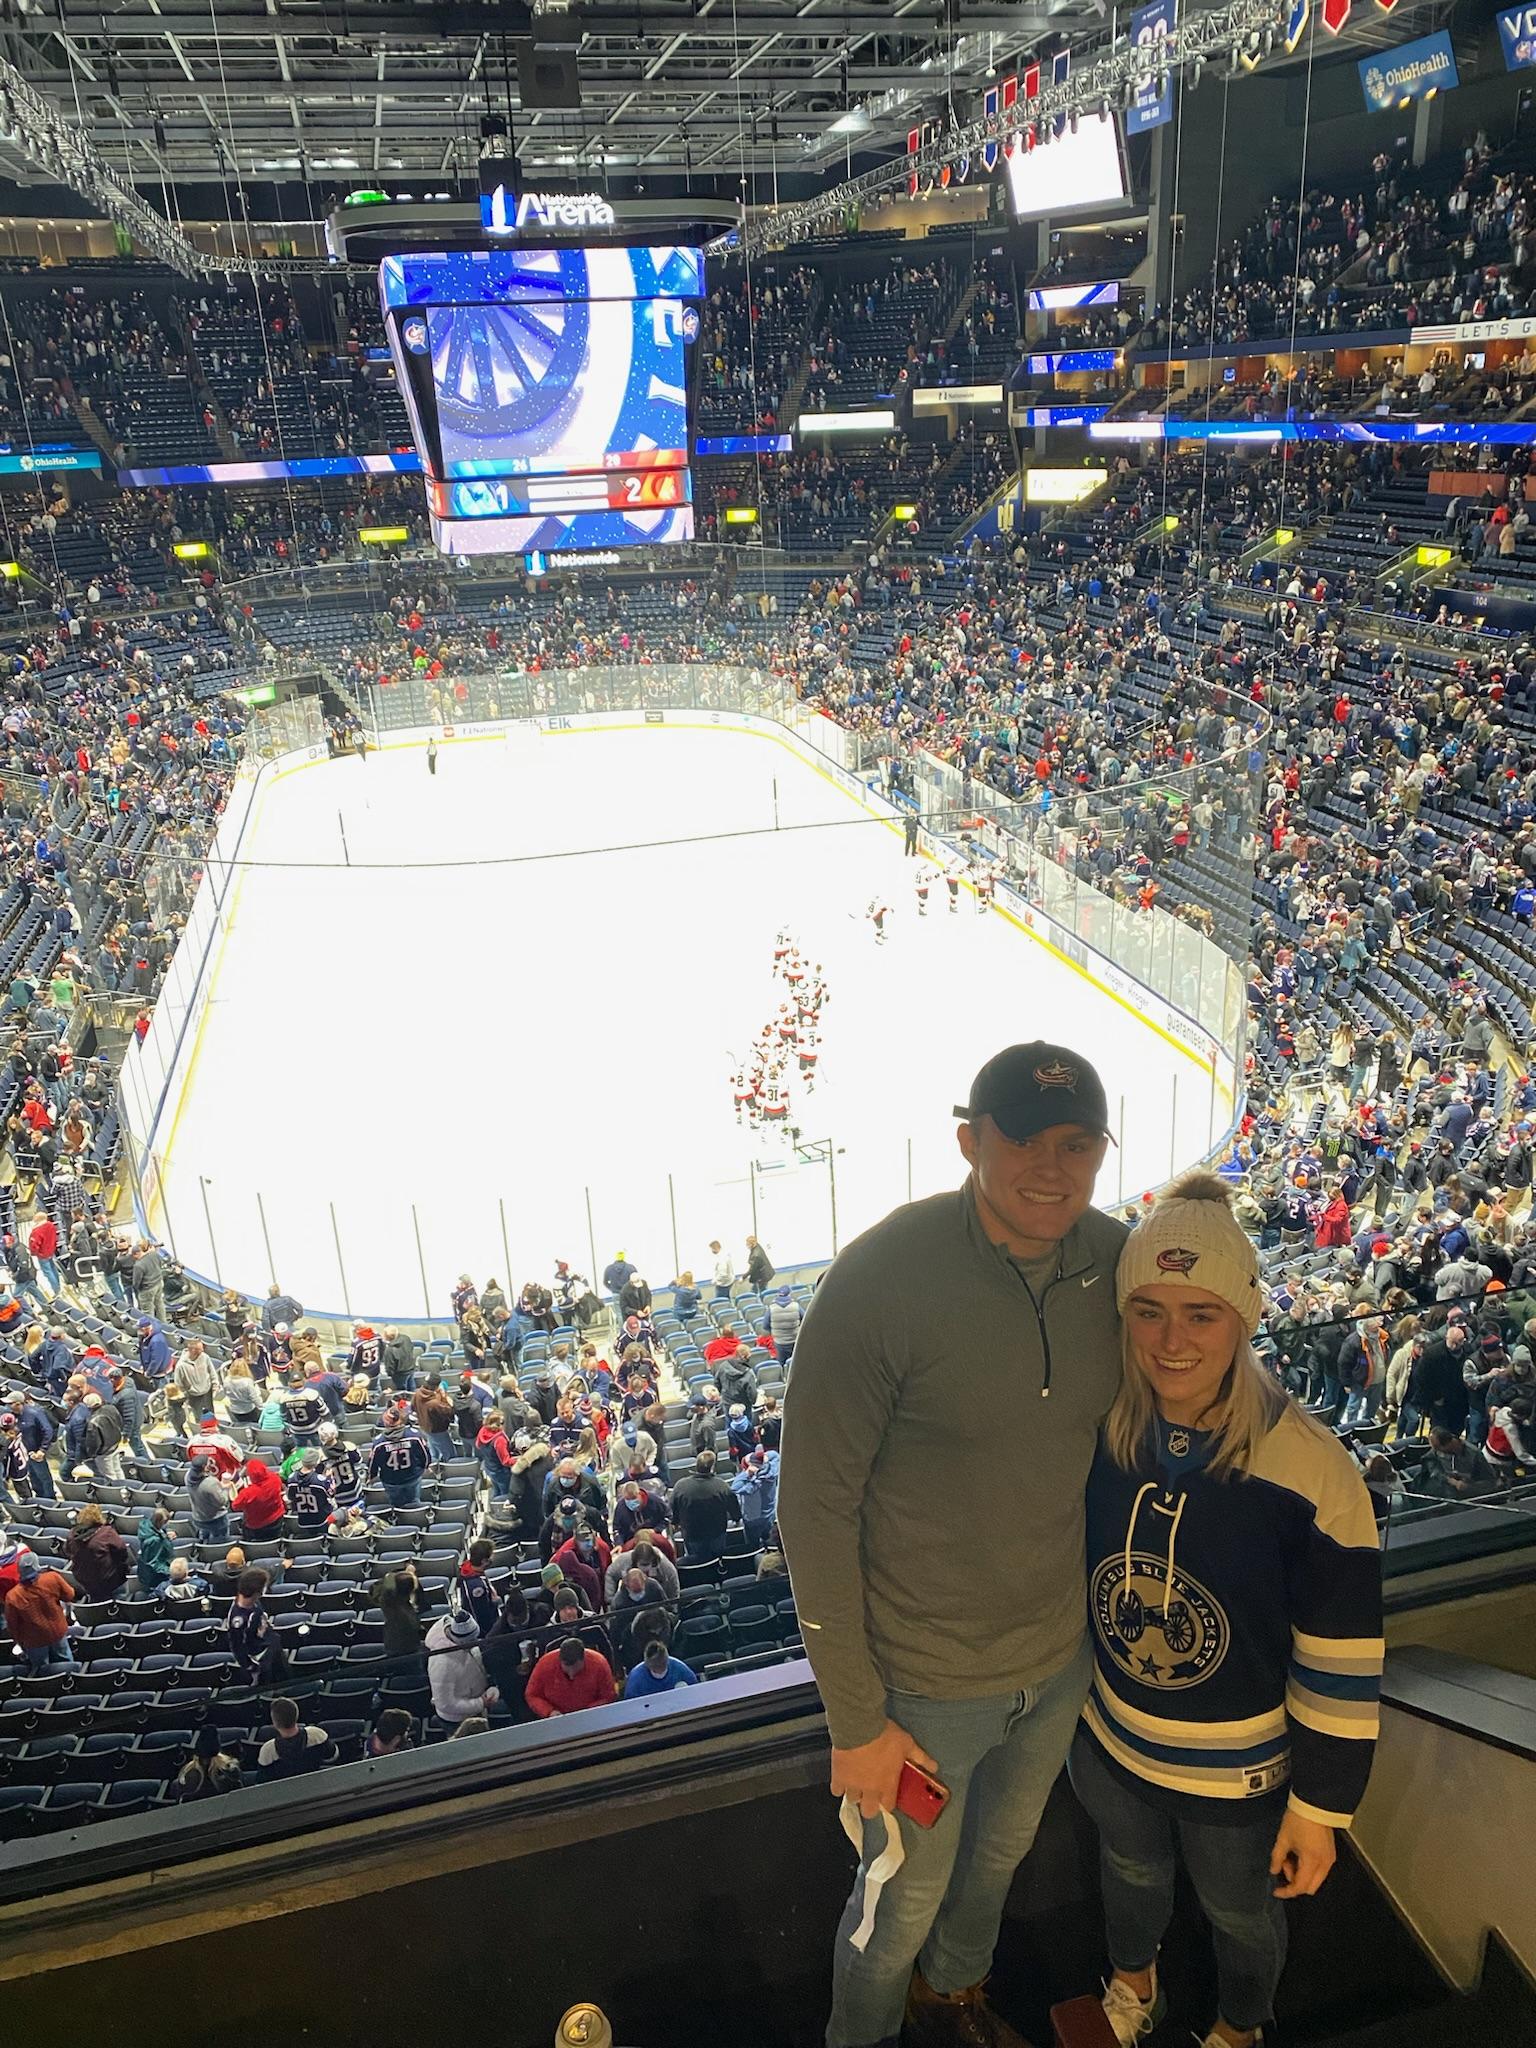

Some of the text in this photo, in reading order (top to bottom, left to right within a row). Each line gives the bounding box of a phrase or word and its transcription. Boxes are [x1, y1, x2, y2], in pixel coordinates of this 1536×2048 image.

[1386, 52, 1450, 87] OhioHealth
[540, 192, 603, 206] Nationwide
[515, 193, 616, 227] Arena
[1462, 324, 1510, 339] LET'S
[35, 457, 78, 467] OhioHealth
[627, 477, 641, 502] 2
[550, 551, 621, 567] Nationwide
[549, 717, 572, 730] Elk
[768, 1089, 778, 1102] 31
[289, 1406, 309, 1423] 13
[386, 1449, 411, 1471] 43
[295, 1493, 319, 1513] 29
[1191, 1598, 1217, 1668] JACKETS
